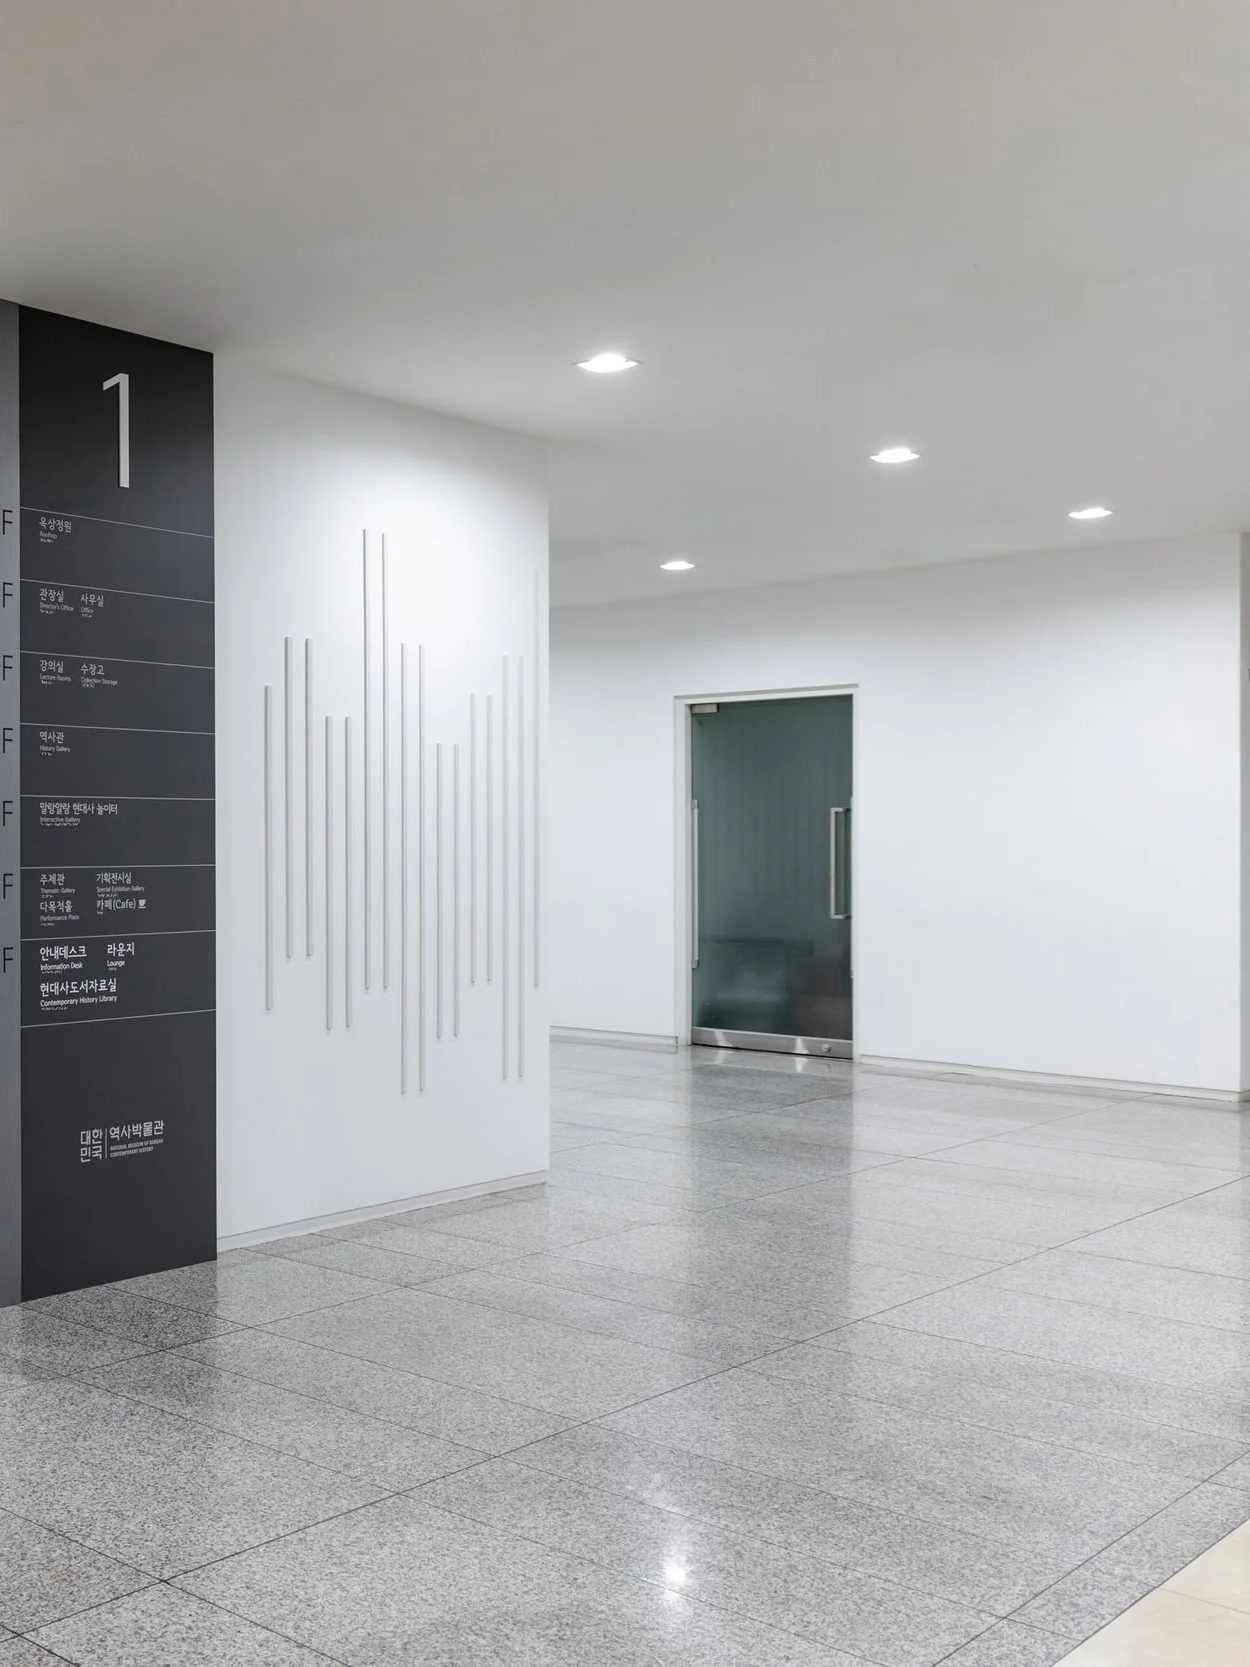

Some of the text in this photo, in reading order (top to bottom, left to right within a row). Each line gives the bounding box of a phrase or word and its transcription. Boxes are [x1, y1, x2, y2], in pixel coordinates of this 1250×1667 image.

[102, 373, 130, 489] 1
[39, 517, 72, 533] 옥상정원
[39, 530, 58, 540] Rooftop
[39, 588, 64, 603] 관장실
[81, 593, 104, 608] 사무실
[39, 602, 74, 612] Director's Office
[81, 606, 94, 614] Office
[39, 660, 64, 673] 강의실
[80, 663, 105, 676] 수장고
[39, 673, 71, 682] Lecture Rooms
[81, 676, 118, 686] Collection Storage
[39, 731, 65, 744] 역사관
[39, 744, 55, 752] History
[39, 802, 118, 815] 말랑말랑 현대사 놀이터
[65, 816, 80, 824] Gallery
[39, 873, 65, 885] 주제관
[96, 871, 132, 884] 기획전시실
[60, 887, 76, 895] Gallery
[131, 885, 145, 893] Gallery
[39, 900, 73, 913] 다목적홀
[96, 898, 137, 911] 카페(Cafe)
[39, 945, 87, 961] 안내데스크
[106, 942, 135, 957] 라운지
[40, 962, 83, 971] Information Desk
[106, 959, 125, 968] Lounge
[39, 977, 117, 997] 현대사도서자료실
[40, 994, 117, 1007] Contemporary History Library
[80, 1128, 103, 1145] 대한
[109, 1120, 164, 1141] 역사박물관
[110, 1143, 127, 1151] NATIONAL
[80, 1145, 103, 1163] 민국
